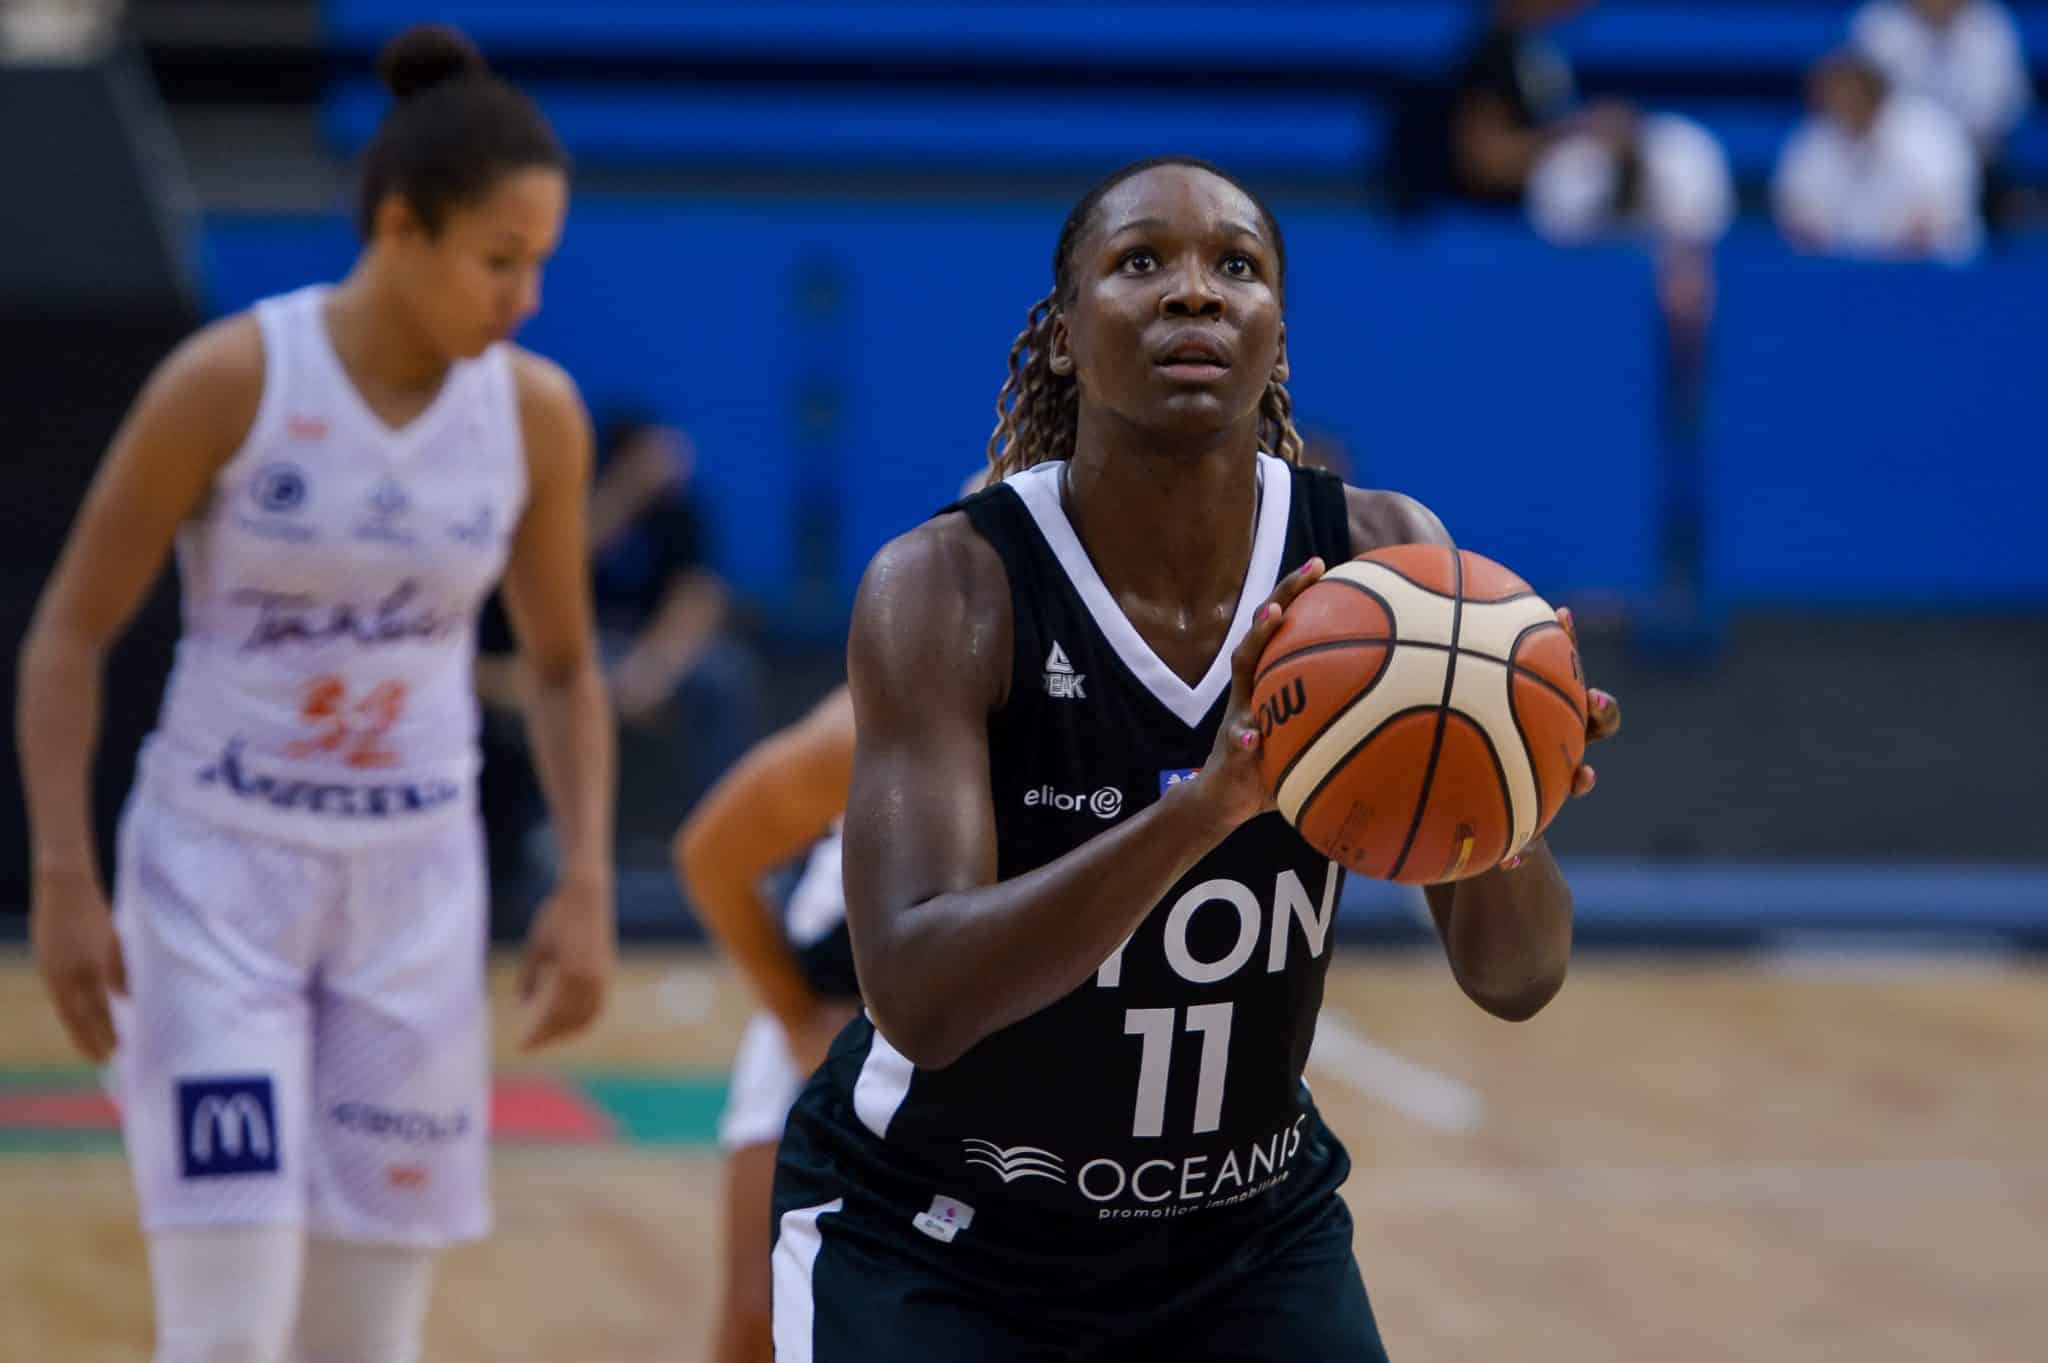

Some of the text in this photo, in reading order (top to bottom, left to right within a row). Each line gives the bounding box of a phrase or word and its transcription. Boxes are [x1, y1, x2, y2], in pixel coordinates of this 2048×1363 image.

[1024, 785, 1085, 811] elior
[1124, 1002, 1234, 1137] 11
[1077, 1113, 1306, 1201] OCEANIS
[1099, 1204, 1199, 1220] promotion
